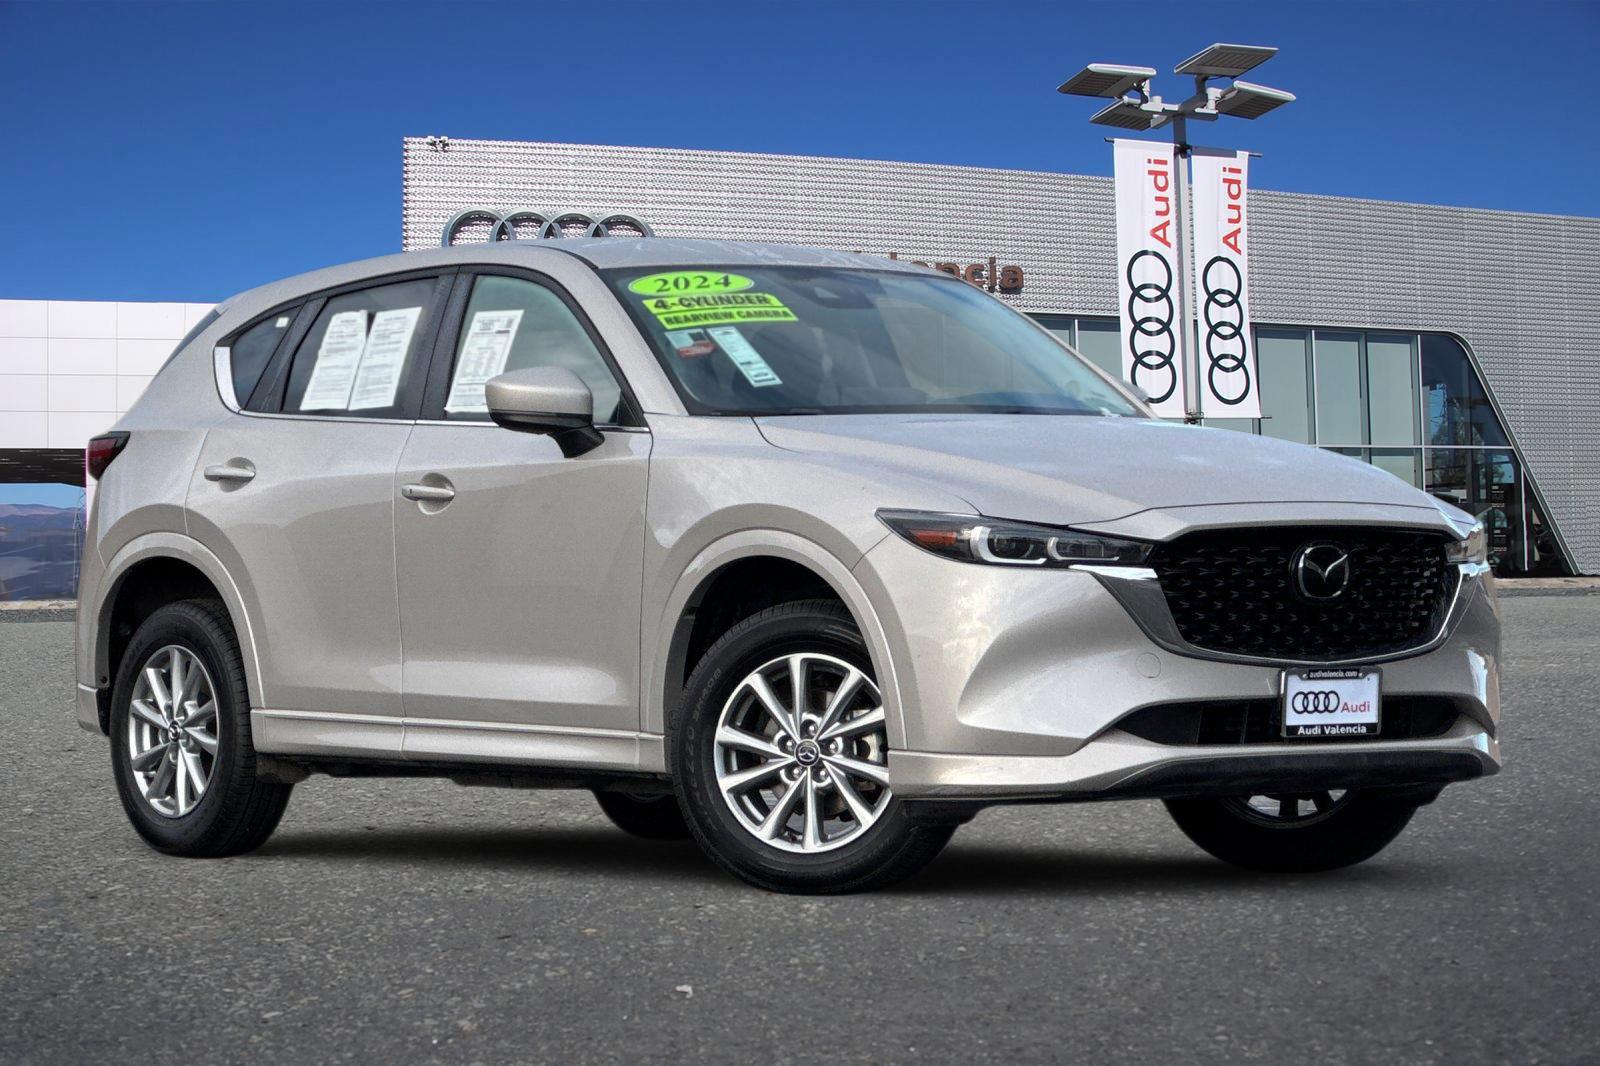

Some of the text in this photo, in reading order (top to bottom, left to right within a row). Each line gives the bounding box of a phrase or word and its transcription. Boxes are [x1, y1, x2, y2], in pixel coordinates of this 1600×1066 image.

[1147, 158, 1171, 249] Audi
[1222, 166, 1242, 256] Audi
[654, 274, 732, 293] 2024
[654, 294, 771, 310] 4-CYLINDER
[664, 308, 792, 326] REARVIEW CAMERA
[1341, 701, 1370, 713] Audi
[1298, 724, 1367, 736] Audi Valencia
